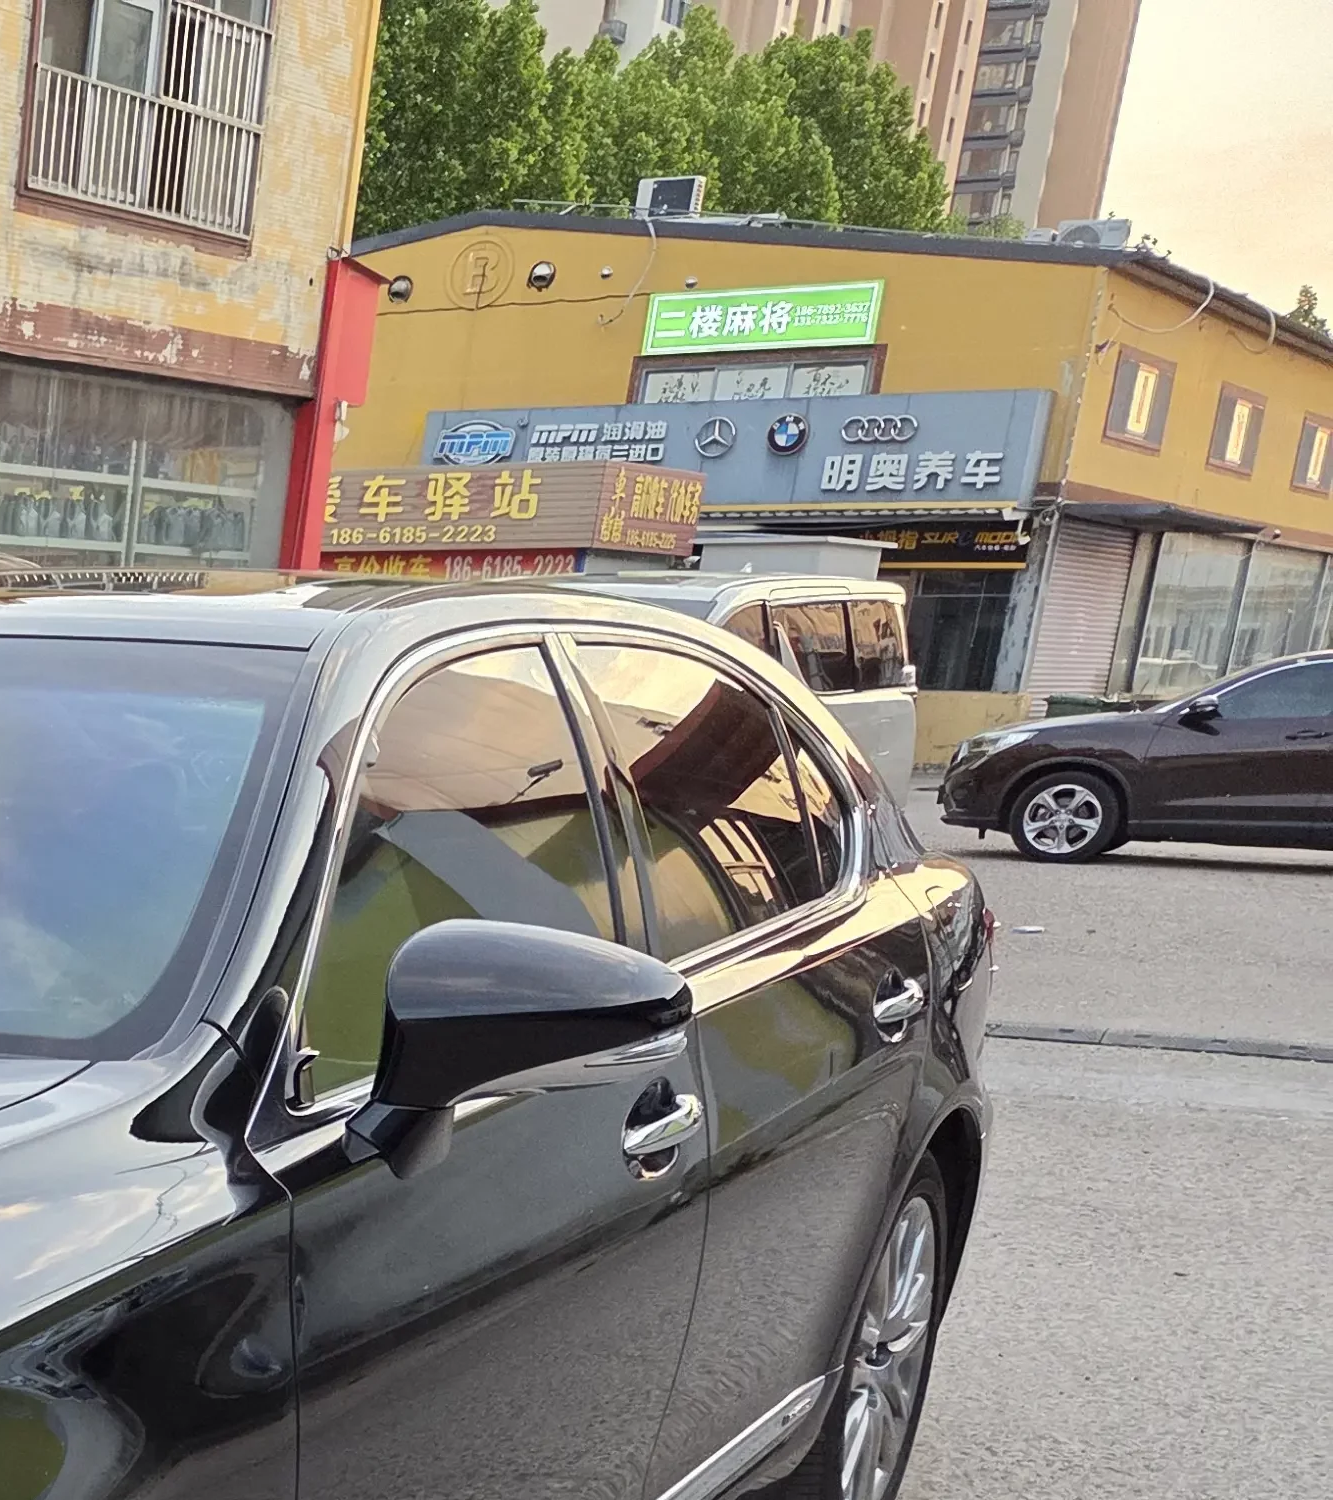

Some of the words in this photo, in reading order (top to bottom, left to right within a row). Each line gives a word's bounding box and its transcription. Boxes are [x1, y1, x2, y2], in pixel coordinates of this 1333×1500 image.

[655, 300, 793, 338] 二楼麻将
[601, 420, 667, 442] 润滑油
[820, 450, 1004, 492] 明奥养车
[330, 524, 497, 545] 186-6185-2223
